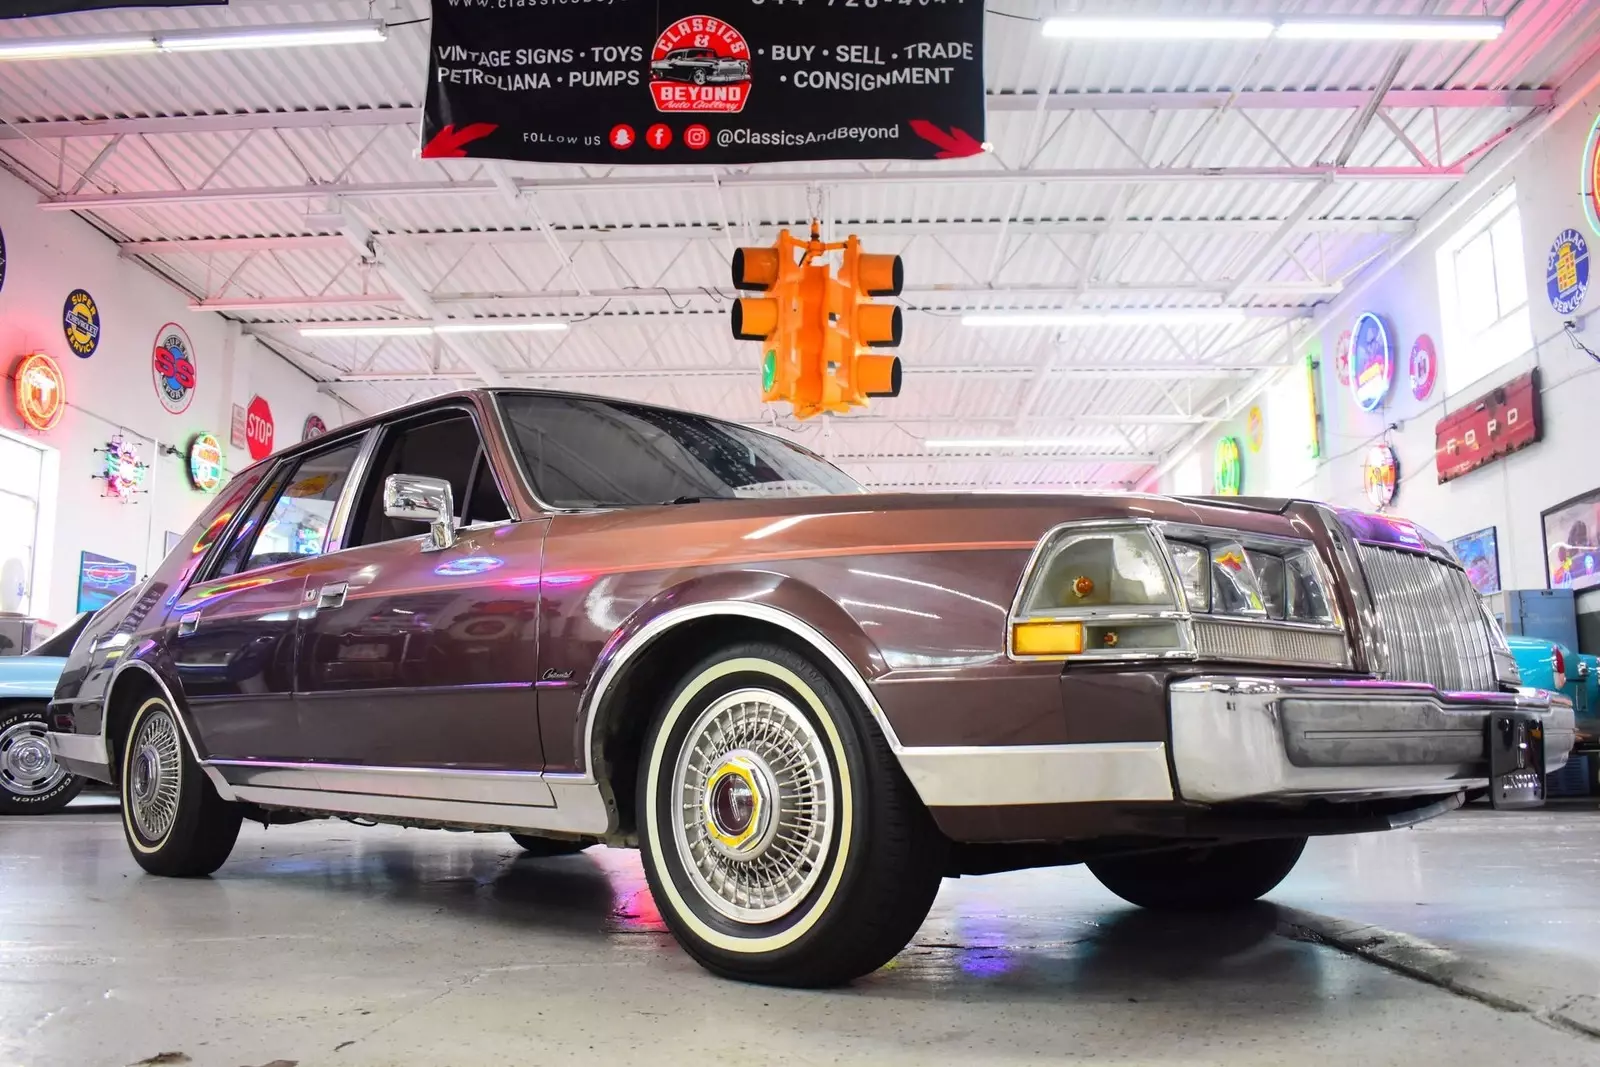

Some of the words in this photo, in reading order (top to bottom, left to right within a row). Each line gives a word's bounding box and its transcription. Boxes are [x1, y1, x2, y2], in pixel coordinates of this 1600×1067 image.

[657, 18, 746, 54] CLASSICS
[694, 34, 710, 48] &
[438, 45, 511, 67] VINTAGE
[515, 49, 574, 65] SIGNS
[591, 46, 643, 62] TOYS
[771, 45, 816, 61] BUY
[835, 45, 886, 65] SELL
[903, 42, 974, 60] TRADE
[437, 67, 552, 91] PETROLIANA
[568, 70, 640, 87] PUMPS
[793, 67, 955, 91] CONSIGNMENT
[661, 86, 741, 101] BEYOND
[662, 100, 690, 109] Auto
[692, 100, 739, 111] Gallery
[523, 132, 578, 145] FOLLOW
[584, 135, 601, 146] US
[716, 124, 900, 147] @ClassicsAndBeyond
[1547, 229, 1585, 270] CADILLAC
[71, 293, 96, 316] SUPER
[1552, 280, 1587, 313] SERVICE
[67, 312, 98, 336] CHEVROLET
[67, 327, 95, 353] SERVICE
[154, 346, 194, 388] SS
[247, 413, 273, 446] STOP
[12, 774, 75, 803] Goodrich
